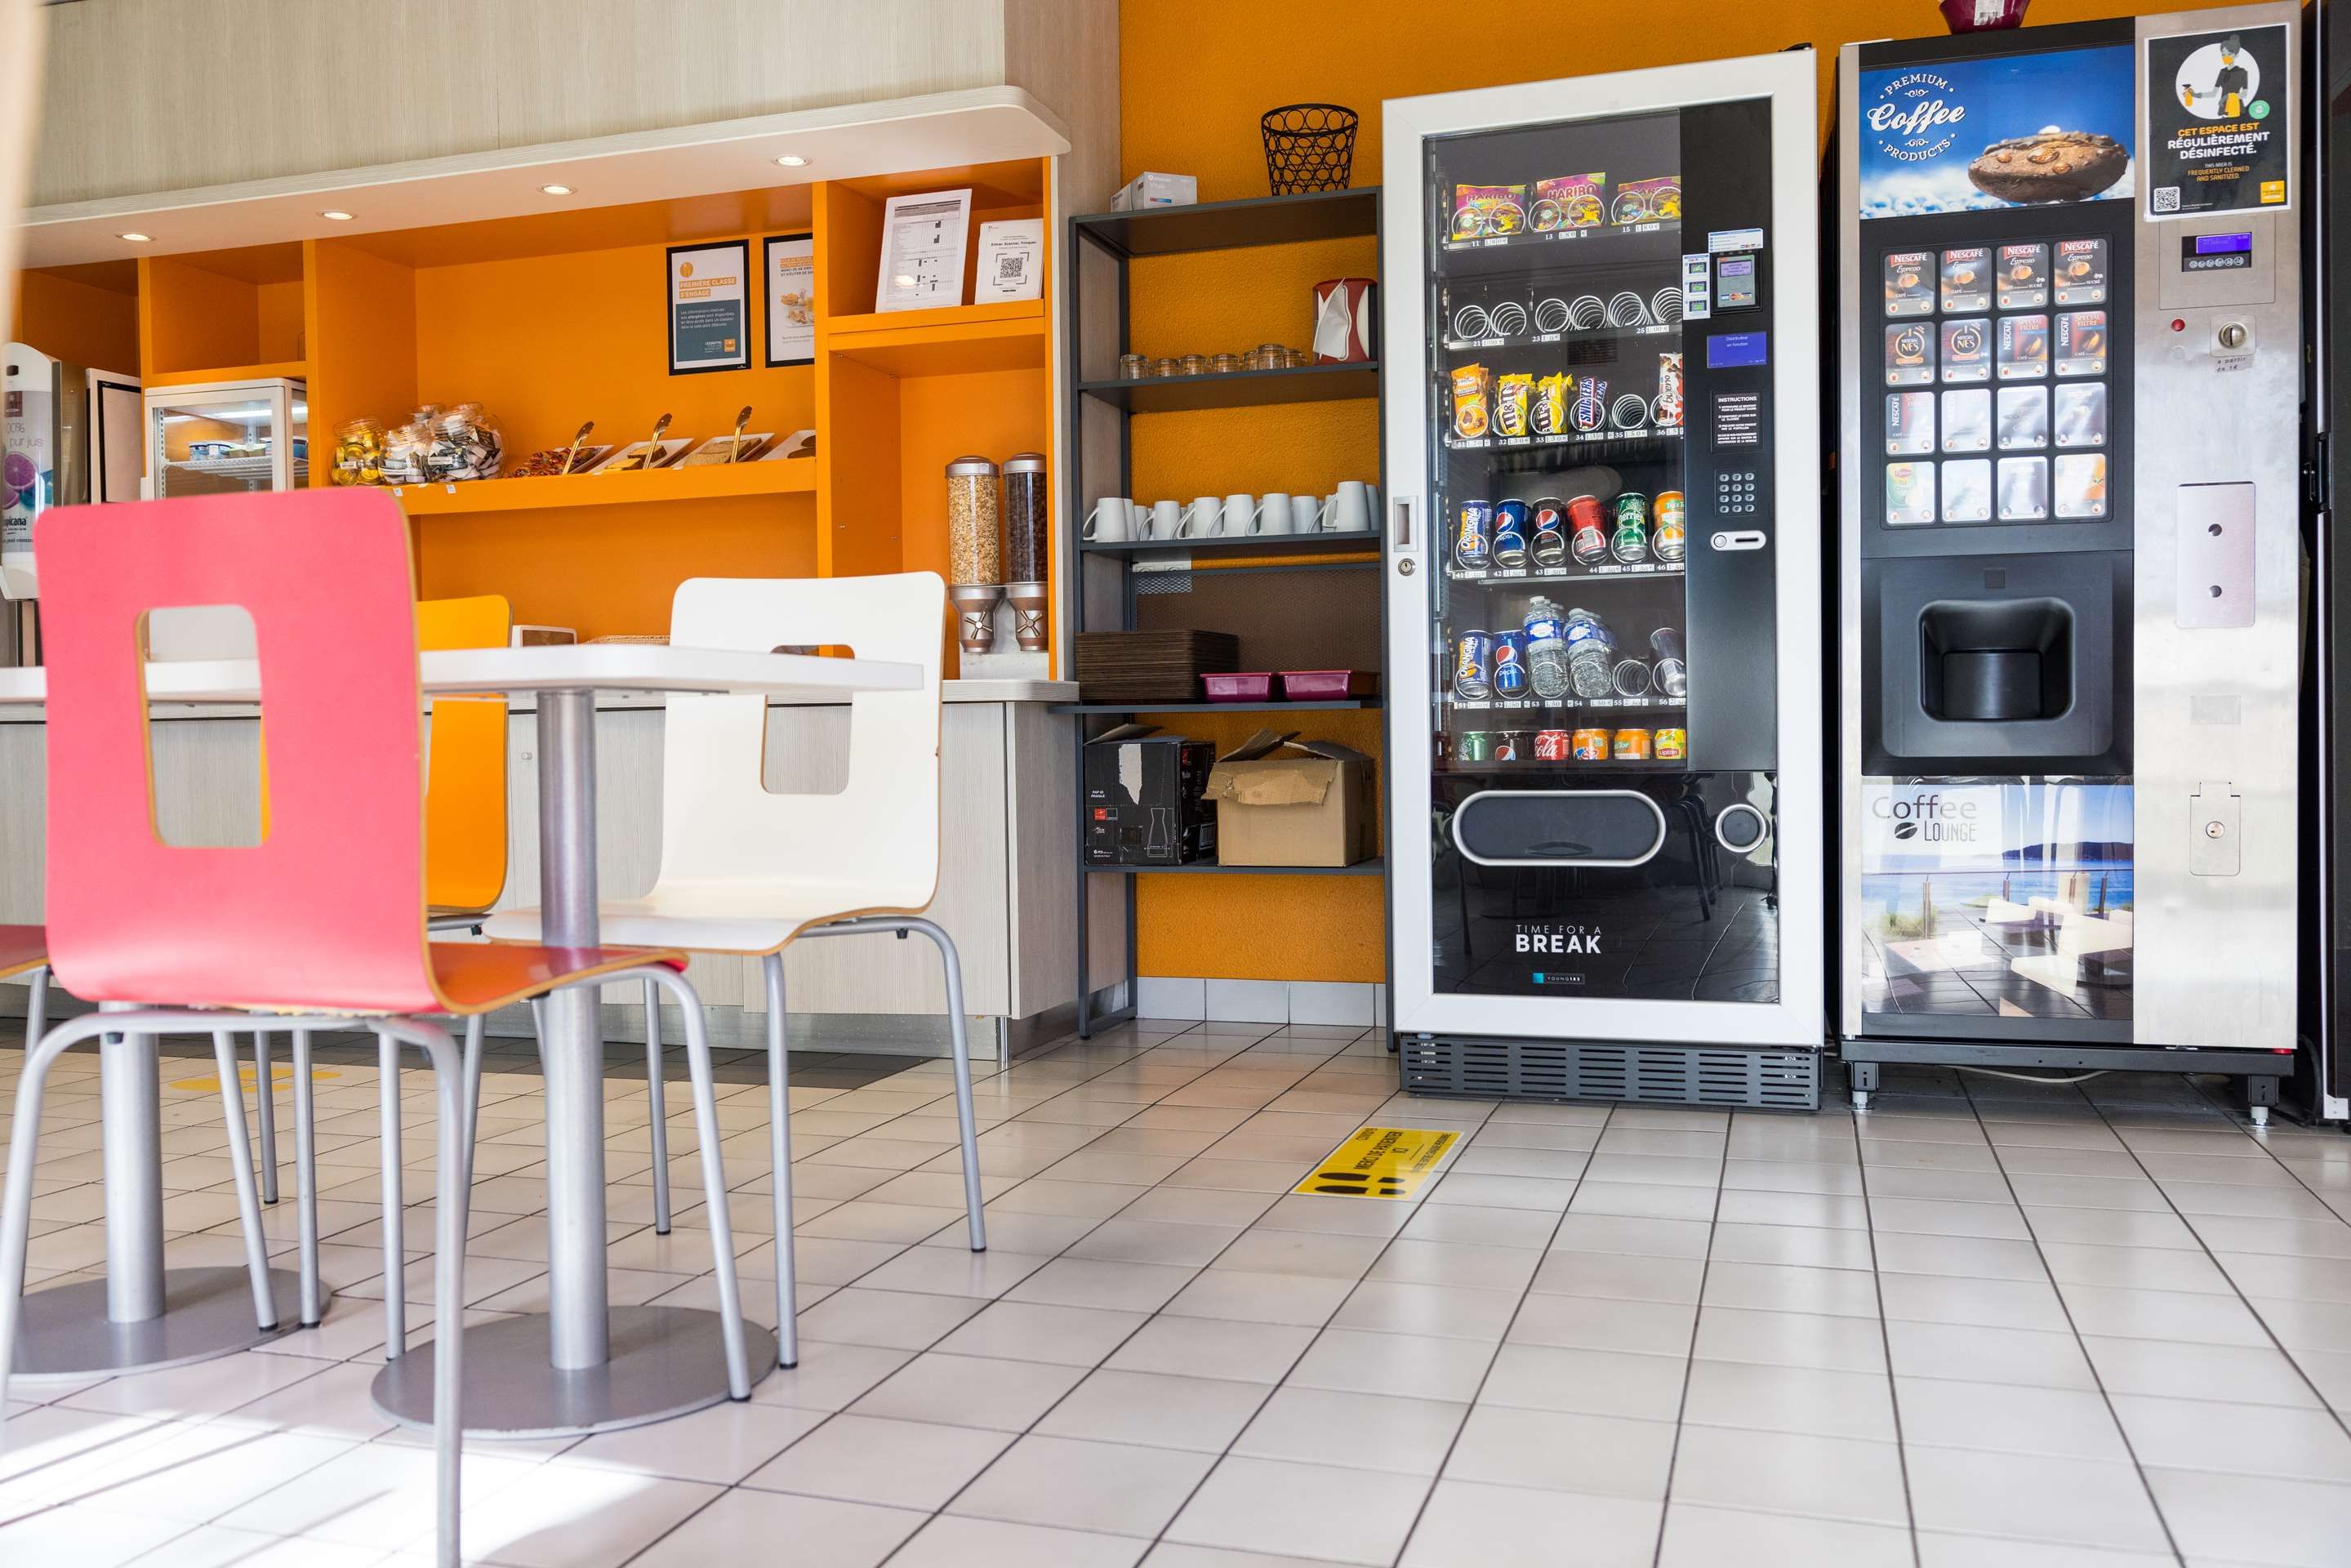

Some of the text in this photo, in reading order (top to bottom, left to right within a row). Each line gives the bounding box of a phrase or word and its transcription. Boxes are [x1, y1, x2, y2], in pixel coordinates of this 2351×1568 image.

[1884, 73, 1948, 95] PREMIUM
[1867, 100, 1966, 136] Coffee
[2178, 122, 2260, 137] CET ESPACE EST
[2167, 131, 2270, 149] RÉGULIÈREMENT
[1883, 139, 1951, 161] PRODUCTS
[2180, 142, 2257, 160] DÉSINFECTÉ.
[2188, 165, 2250, 176] FREQUENTLY CLEANED
[1547, 185, 1596, 199] HARIBO
[2007, 244, 2041, 255] NESCAFÉ
[2064, 240, 2099, 251] NESCAFÉ
[1895, 252, 1927, 262] NESCAFÉ
[1950, 248, 1984, 259] NESCAFÉ
[2067, 254, 2093, 262] Espresso
[2010, 257, 2035, 266] Espresso
[1896, 265, 1921, 274] Espresso
[711, 278, 736, 286] CLASSE
[2003, 320, 2012, 350] NESCAFÉ
[2060, 315, 2069, 346] NESCAFÉ
[1901, 342, 1919, 352] NES
[1957, 340, 1975, 349] NES
[1663, 375, 1674, 404] bueno
[1581, 378, 1593, 423] SNICKERS
[1891, 397, 1899, 426] NESCAFÉ
[9, 438, 44, 448] pur jus
[1462, 508, 1479, 549] ORANGINA
[1459, 637, 1476, 677] ORANGINA
[1498, 669, 1518, 677] pepsi
[1872, 795, 1976, 819] Coffee
[1924, 820, 1976, 841] LOUNGE
[1516, 924, 1601, 934] TIME FOR A
[1516, 933, 1601, 954] BREAK
